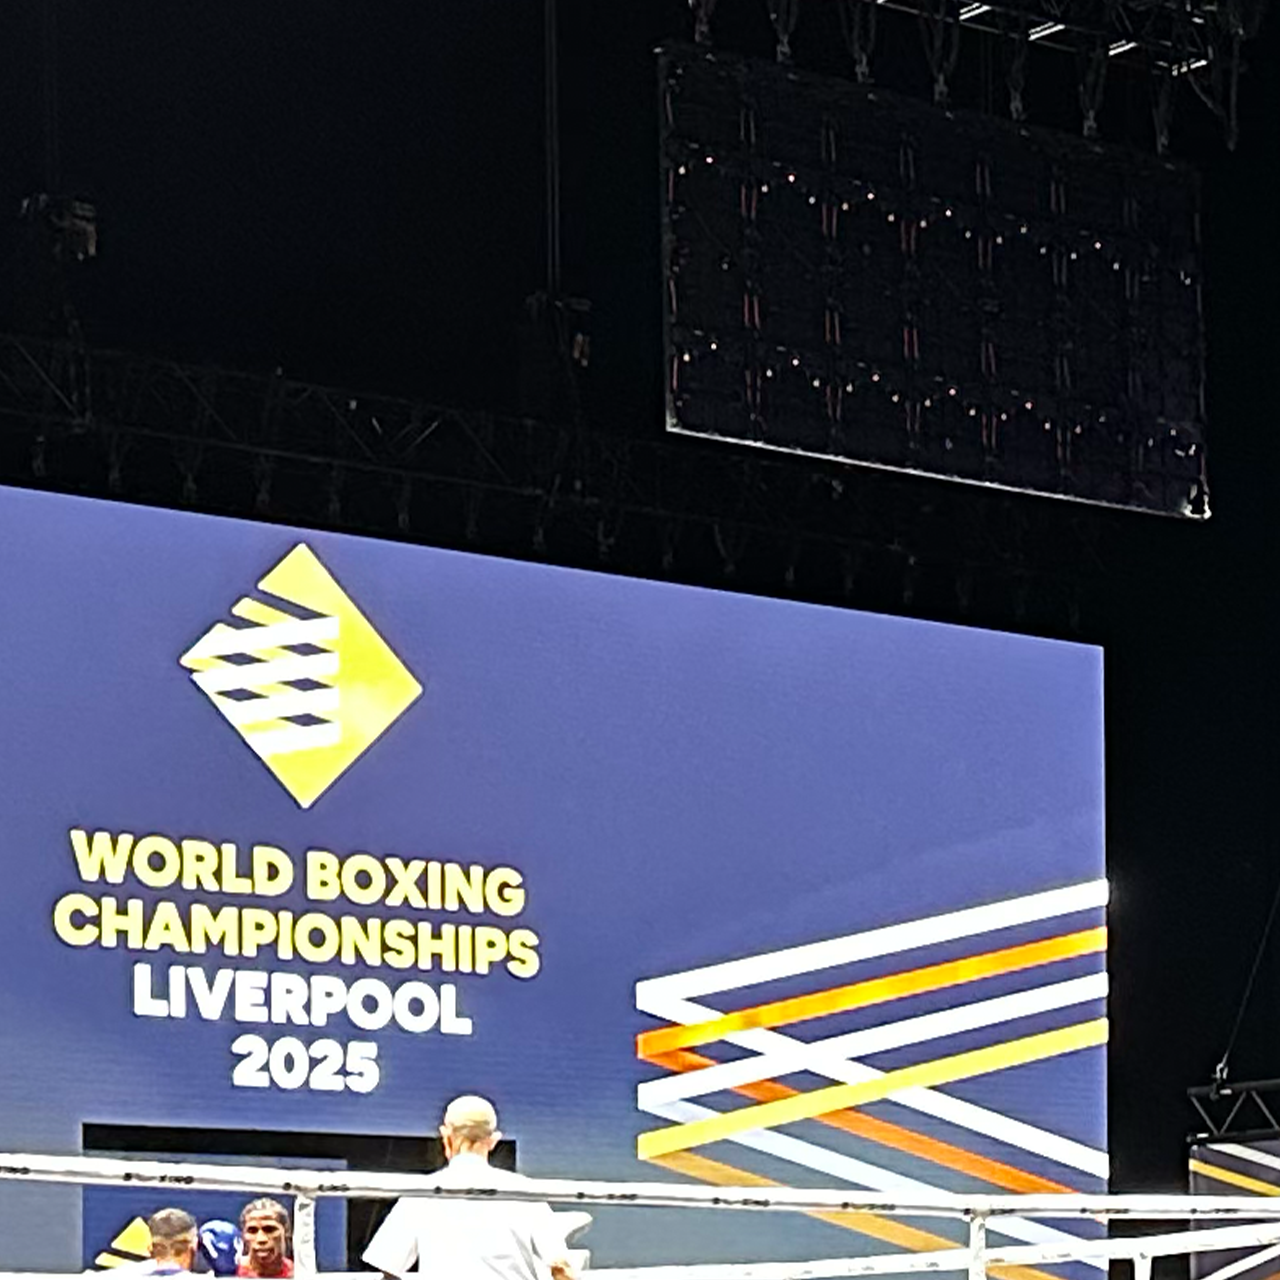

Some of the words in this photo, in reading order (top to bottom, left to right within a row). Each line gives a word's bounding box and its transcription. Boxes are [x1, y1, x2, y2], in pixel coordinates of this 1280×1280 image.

[70, 828, 293, 897] WORLD
[306, 850, 526, 916] BOXING
[53, 893, 541, 978] CHAMPIONSHIPS
[132, 962, 473, 1036] LIVERPOOL
[231, 1034, 380, 1093] 2025
